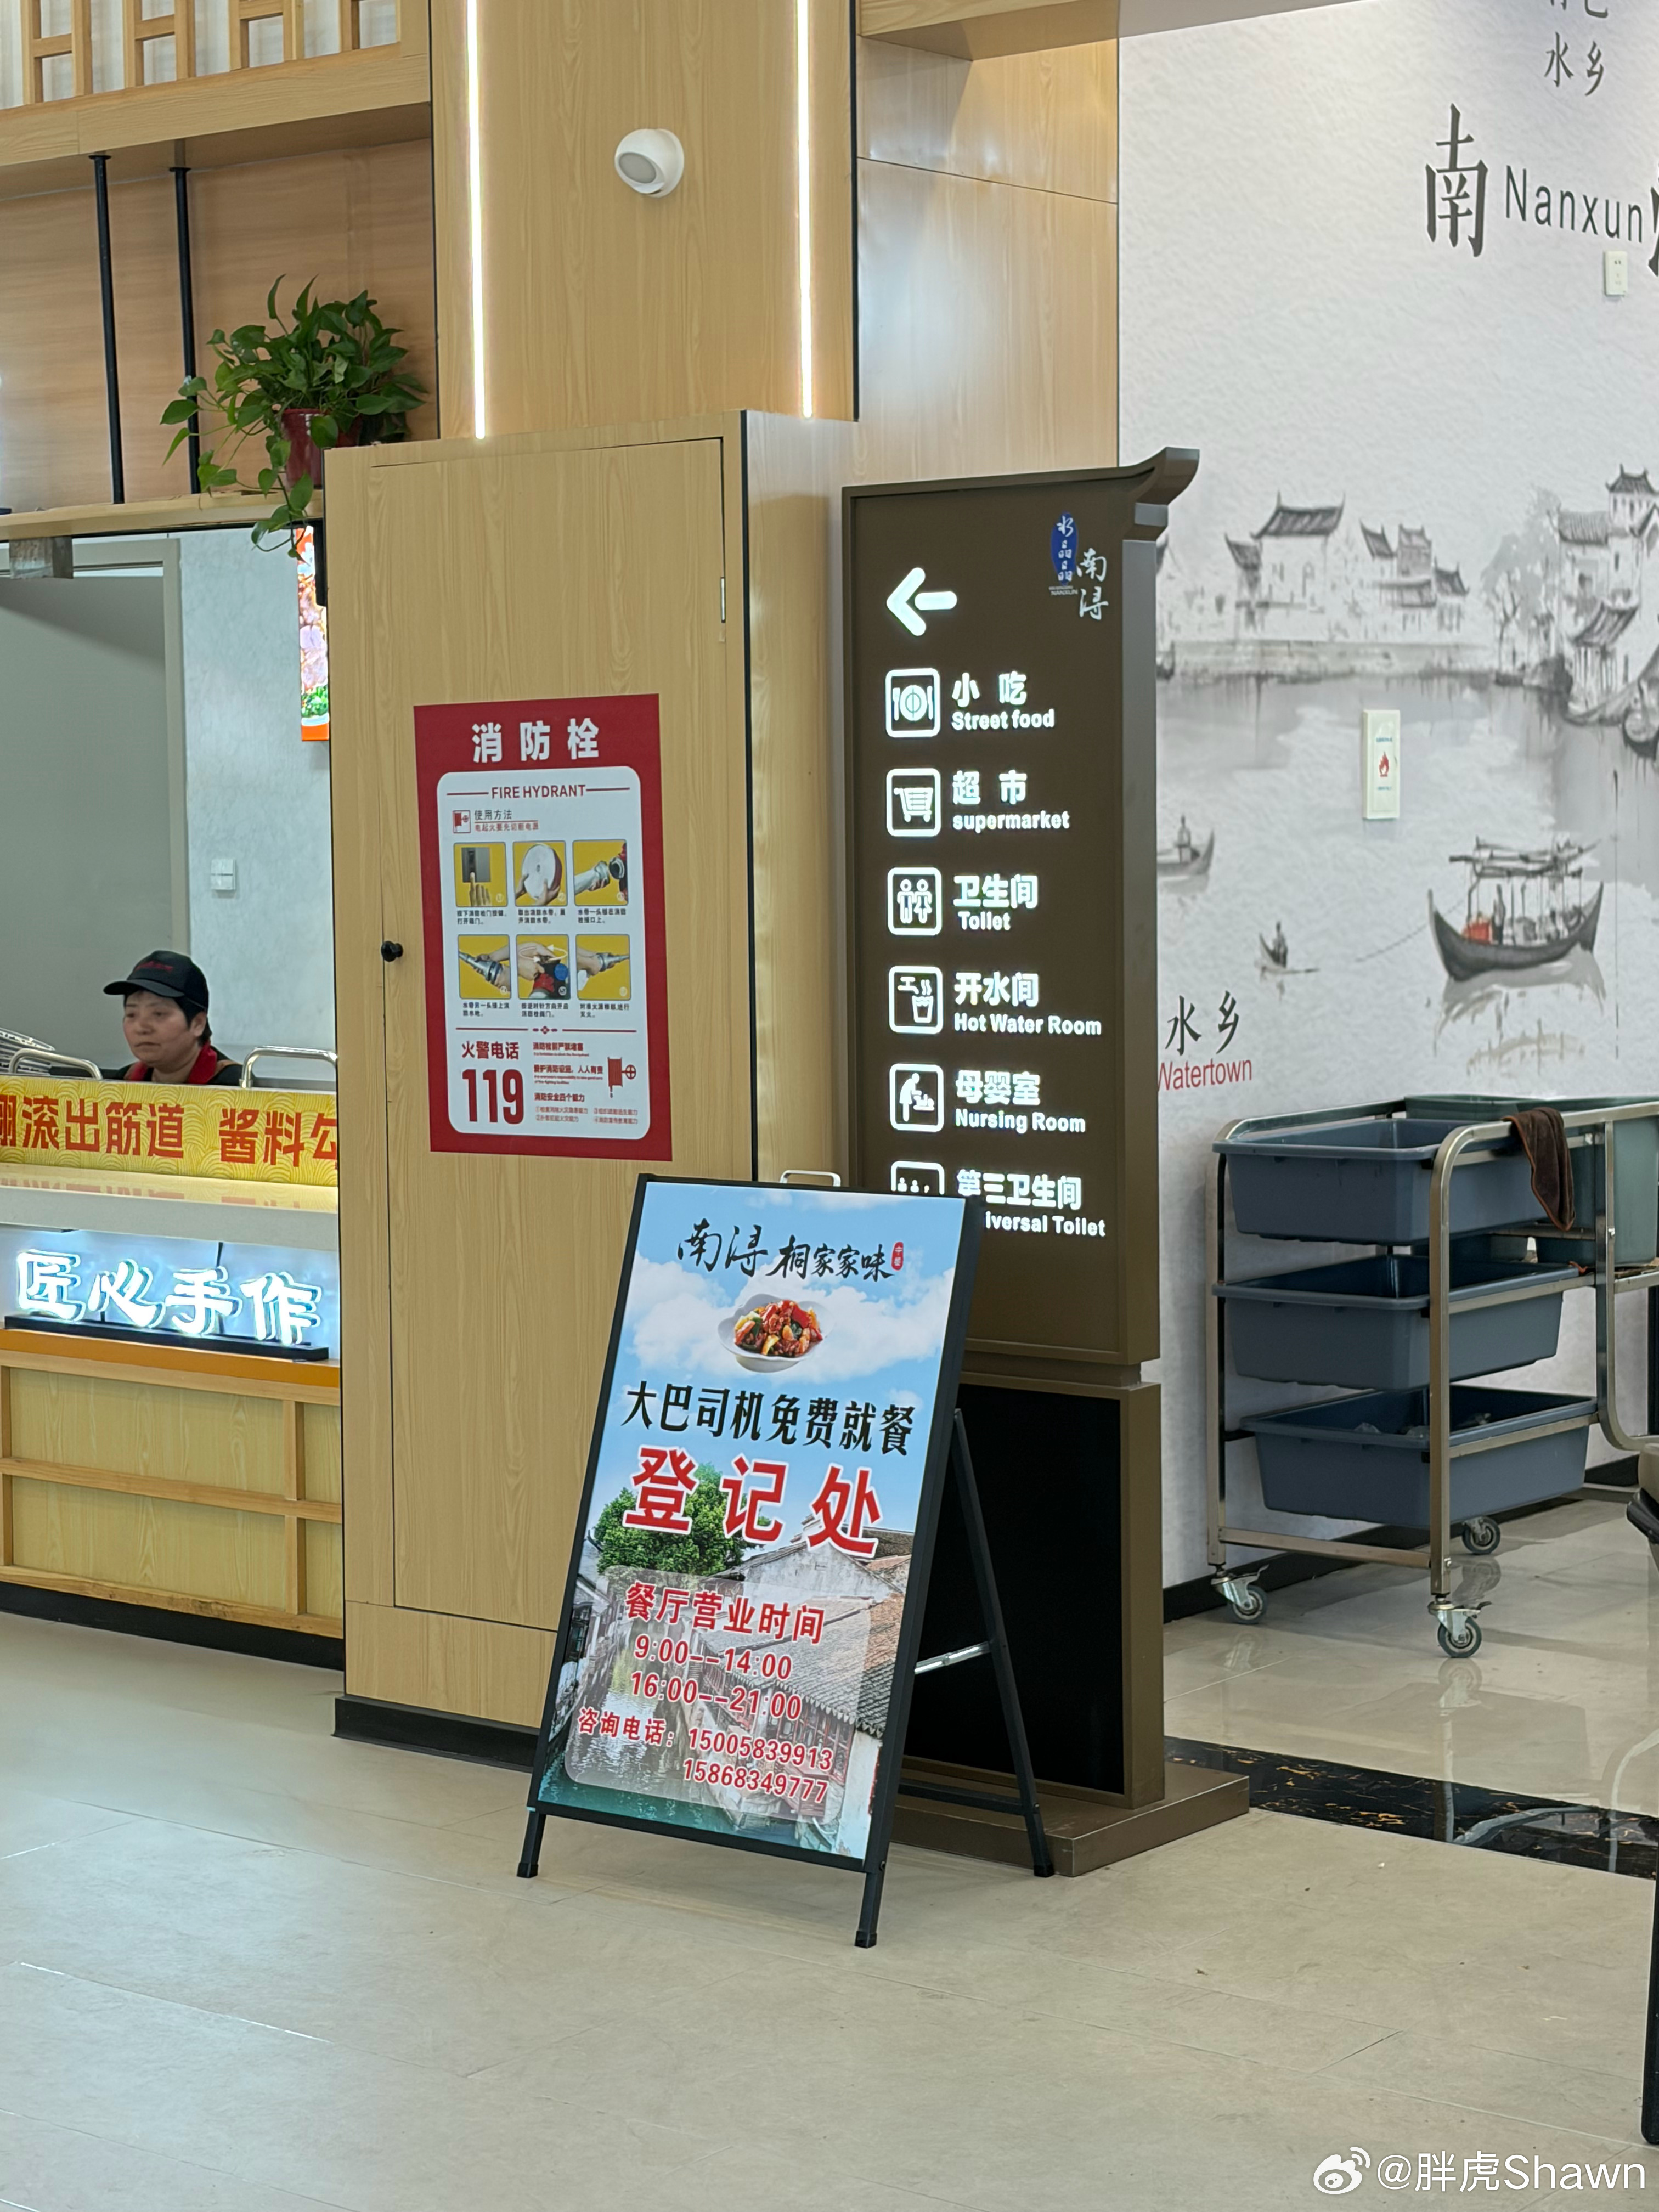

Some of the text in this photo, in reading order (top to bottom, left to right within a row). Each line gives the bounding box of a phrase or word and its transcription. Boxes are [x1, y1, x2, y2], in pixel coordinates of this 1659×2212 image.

[1544, 31, 1604, 96] 水乡
[1425, 103, 1488, 257] 南
[1506, 165, 1643, 243] Nanxun
[952, 671, 1027, 707] 小吃
[951, 708, 1055, 731] Street food
[472, 718, 599, 763] 消防栓
[492, 784, 586, 799] FIRE HYDRANT
[952, 769, 1028, 805] 超市
[475, 809, 512, 820] 使用方法
[952, 810, 1070, 833] supermarket
[953, 873, 1039, 909] 卫生间
[958, 911, 1011, 930] Toilet
[954, 971, 1039, 1007] 开水间
[955, 1013, 1102, 1035] Hot Water Room
[1165, 990, 1239, 1056] 水乡
[461, 1041, 519, 1059] 火警电话
[956, 1070, 1040, 1105] 母婴室
[1158, 1058, 1252, 1091] Watertown
[462, 1069, 524, 1124] 119
[956, 1108, 1085, 1133] Nursing Room
[957, 1169, 1082, 1210] 第三卫生间
[985, 1211, 1106, 1237] iversal Toilet
[15, 1248, 323, 1347] 匠心手作
[620, 1380, 916, 1455] 大巴司机免费就餐
[623, 1446, 882, 1557] 登记处
[625, 1581, 825, 1644] 餐厅营业时间
[578, 1707, 833, 1771] 咨询电话： 15005839913
[684, 1758, 828, 1804] 15868349777
